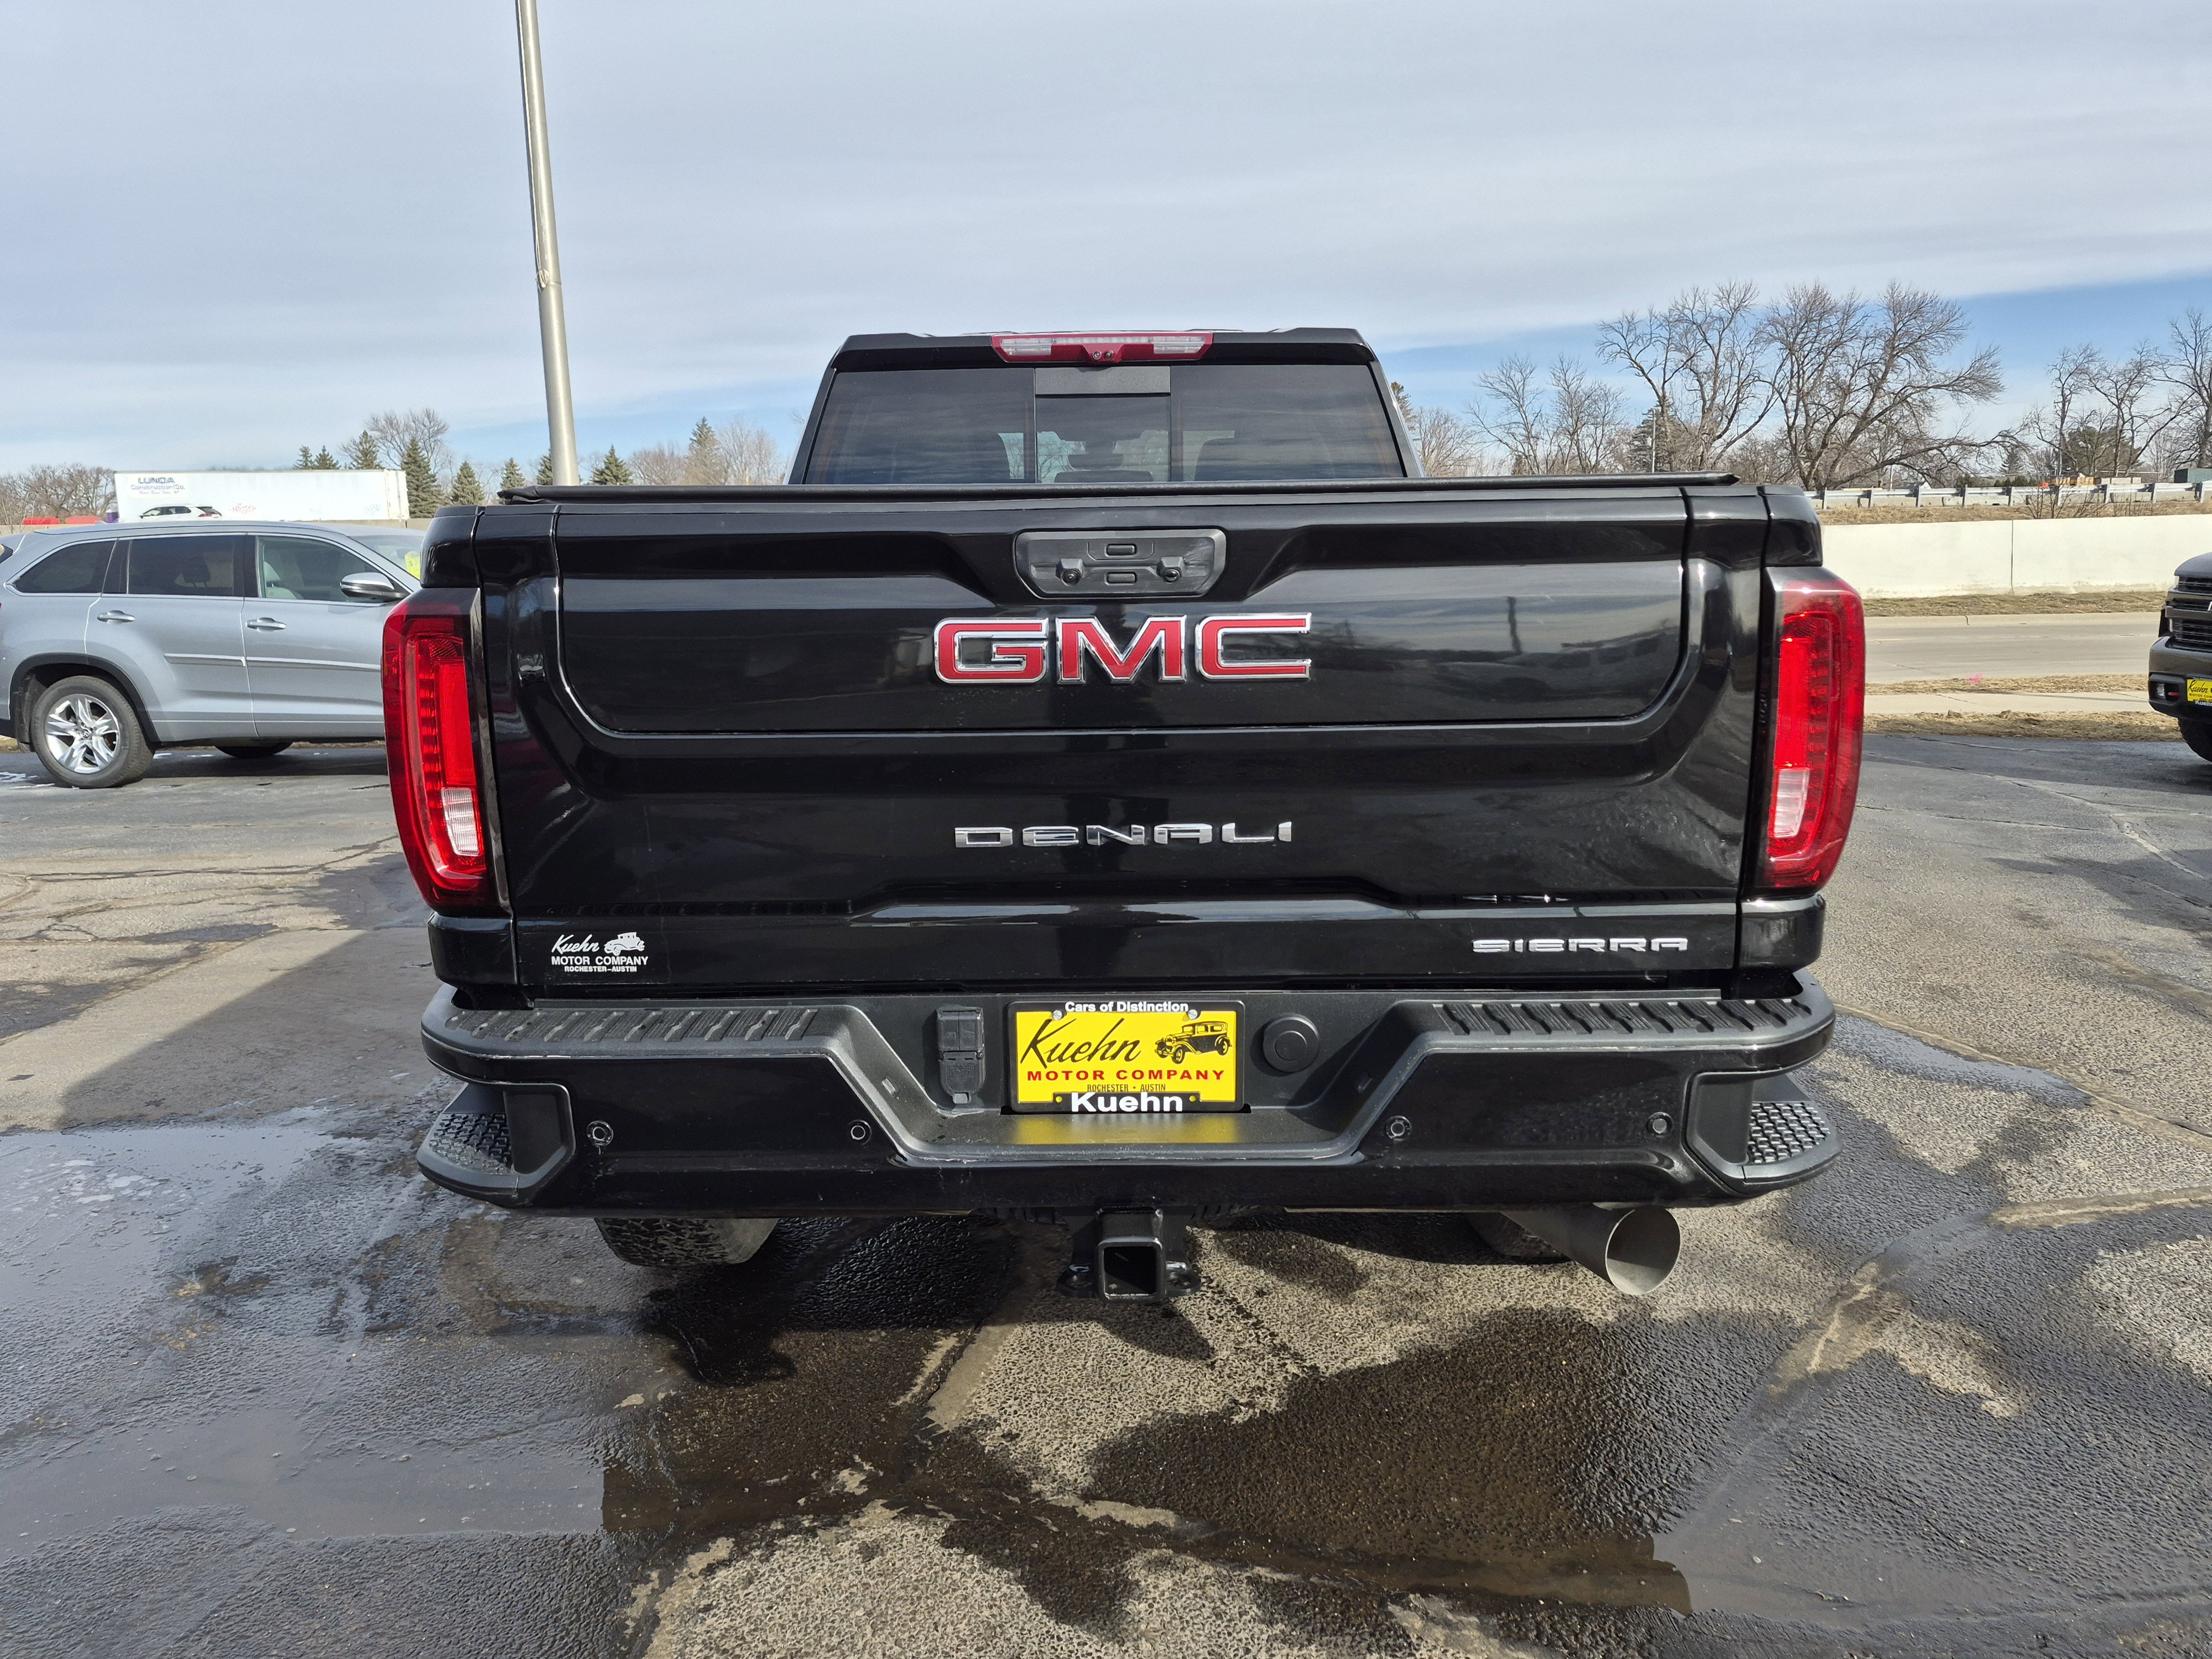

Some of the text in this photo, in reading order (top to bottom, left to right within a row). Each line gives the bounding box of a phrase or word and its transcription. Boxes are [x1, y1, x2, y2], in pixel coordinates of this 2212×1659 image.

[933, 612, 1312, 685] GMC
[2188, 680, 2209, 693] Kuehn
[954, 821, 1292, 848] DENALI
[551, 934, 600, 955] Kuehn
[1472, 938, 1688, 952] SIERRA
[551, 956, 649, 966] MOTOR COMPANY
[1065, 1001, 1189, 1013] Cars of Distinction
[1020, 1018, 1141, 1070] Kuehn
[1027, 1070, 1225, 1081] MOTOR COMPANY
[1087, 1083, 1166, 1092] ROCHESTER AUSTIN
[1071, 1092, 1183, 1113] Kuehn
